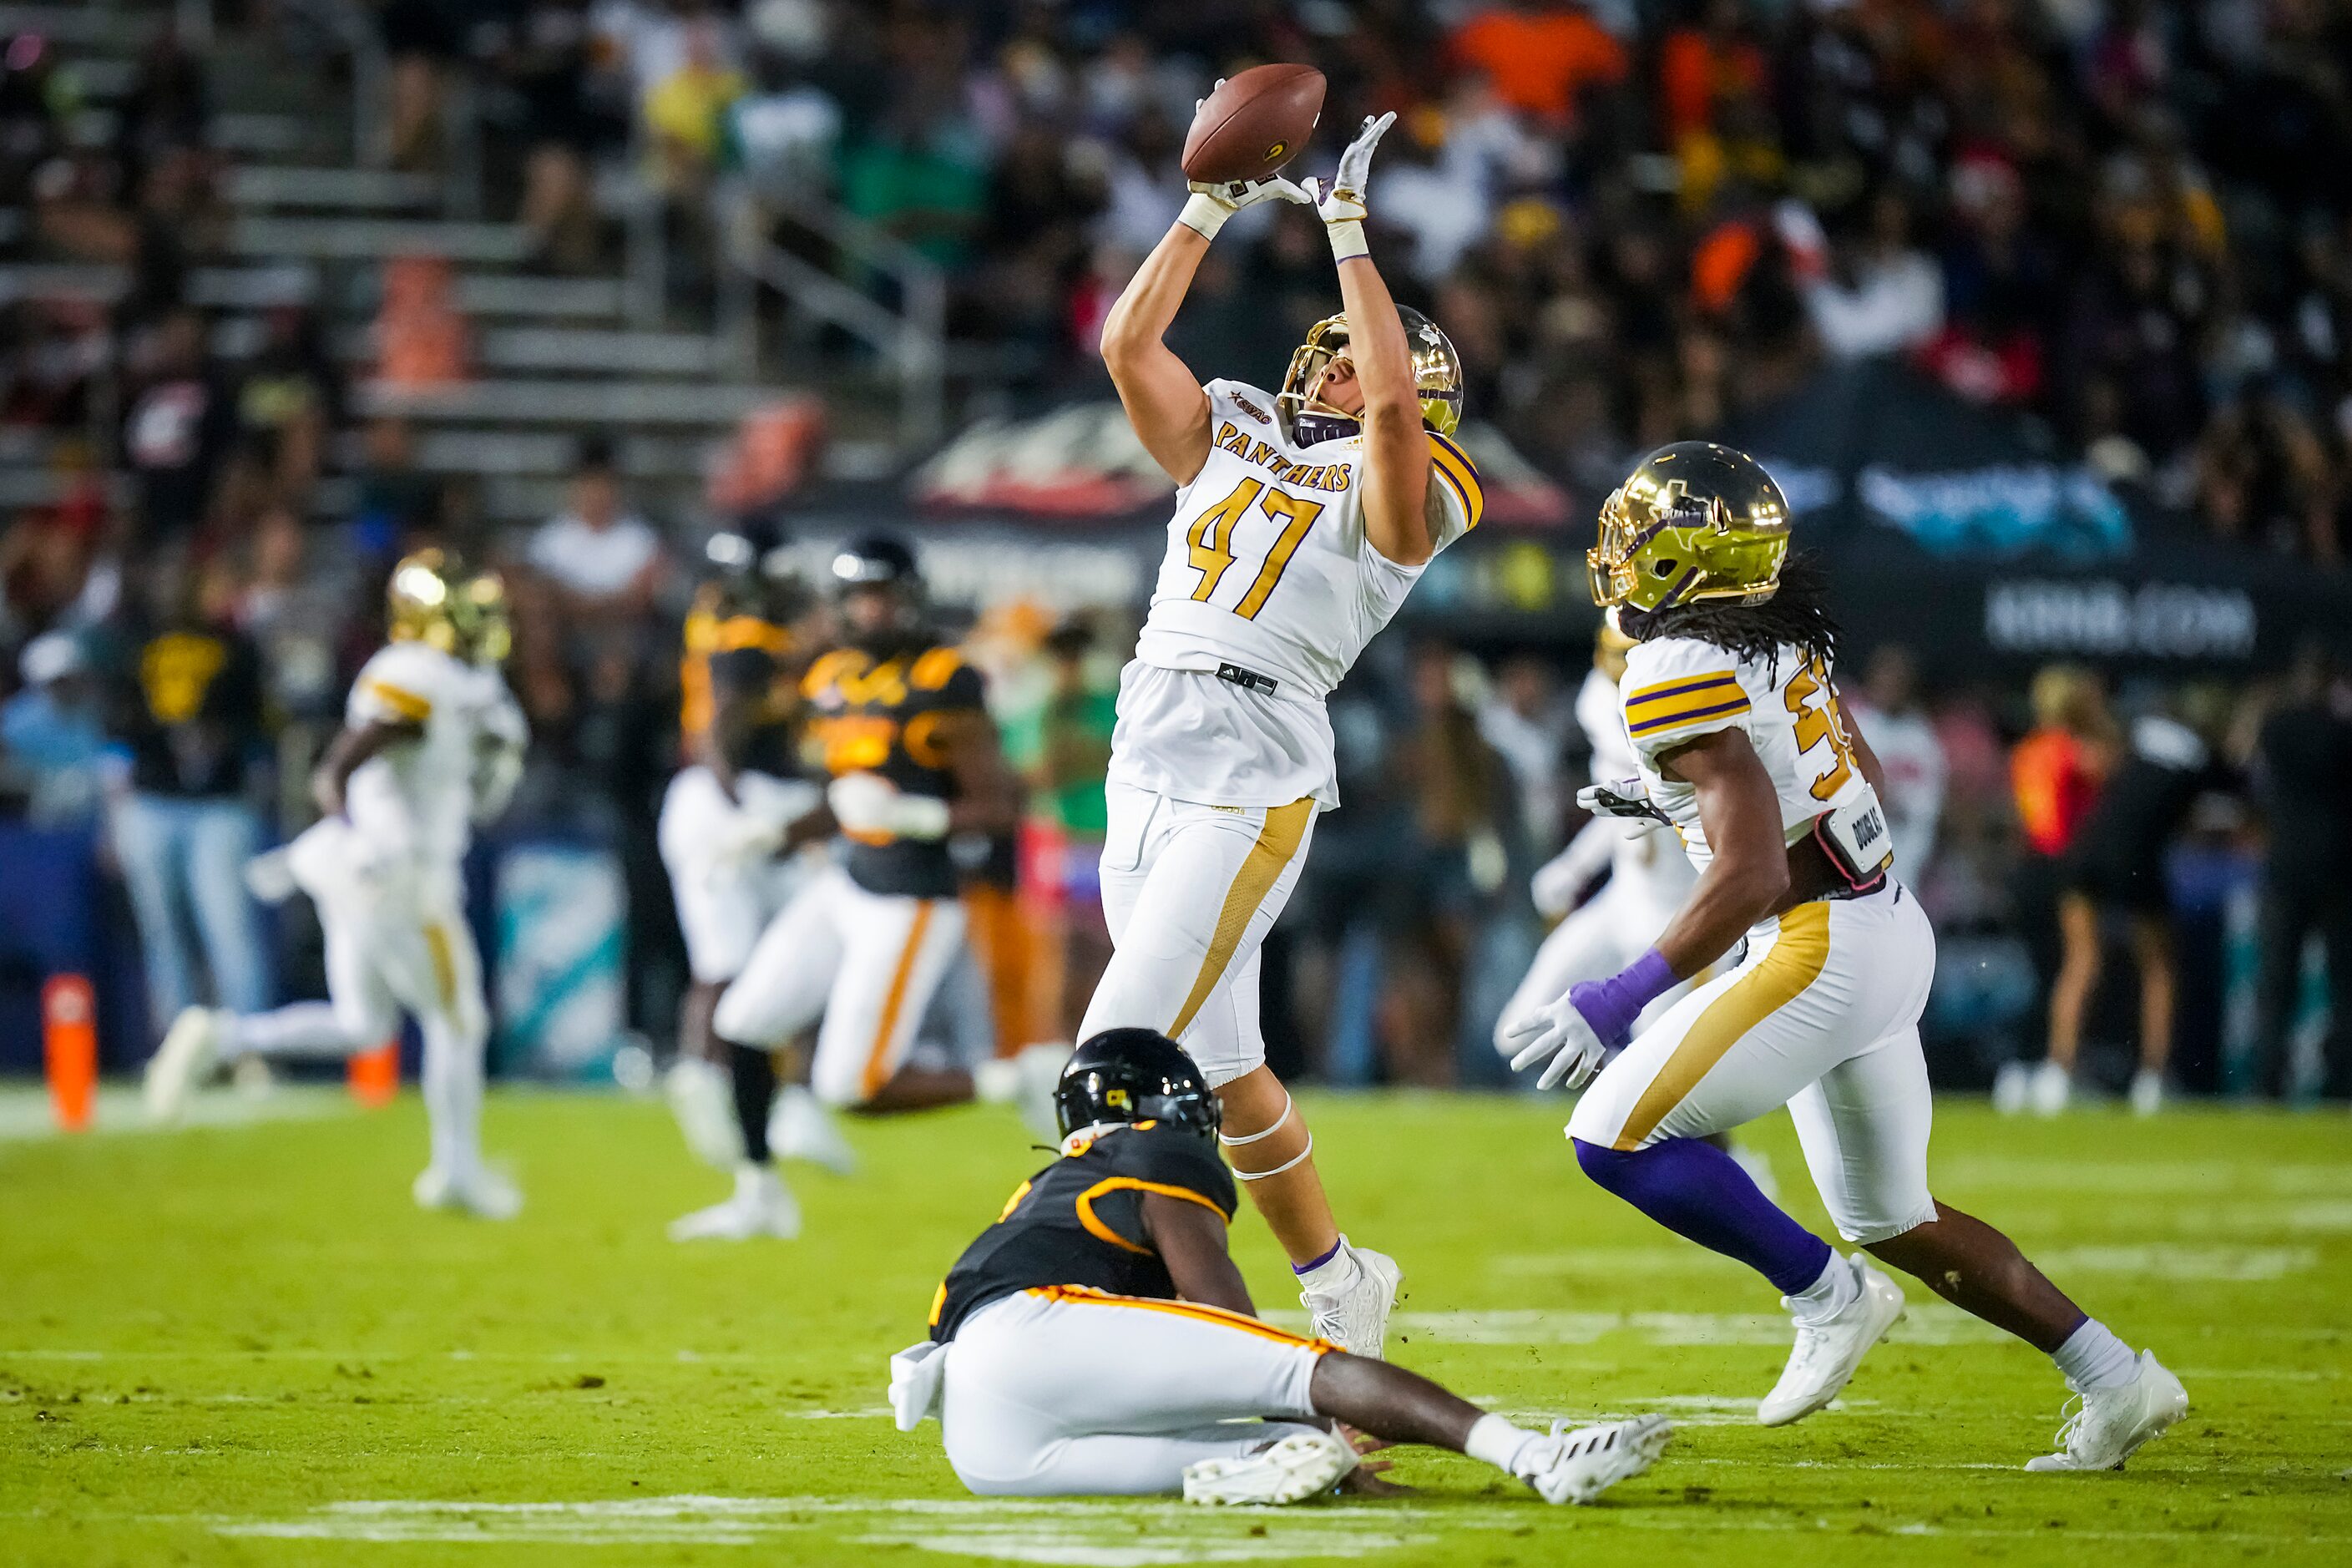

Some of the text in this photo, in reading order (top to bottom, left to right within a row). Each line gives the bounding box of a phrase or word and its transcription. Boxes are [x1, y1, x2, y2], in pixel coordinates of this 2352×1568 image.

[1237, 399, 1272, 425] SWAC
[1215, 420, 1352, 493] PANTHERS
[1186, 476, 1326, 621] 47
